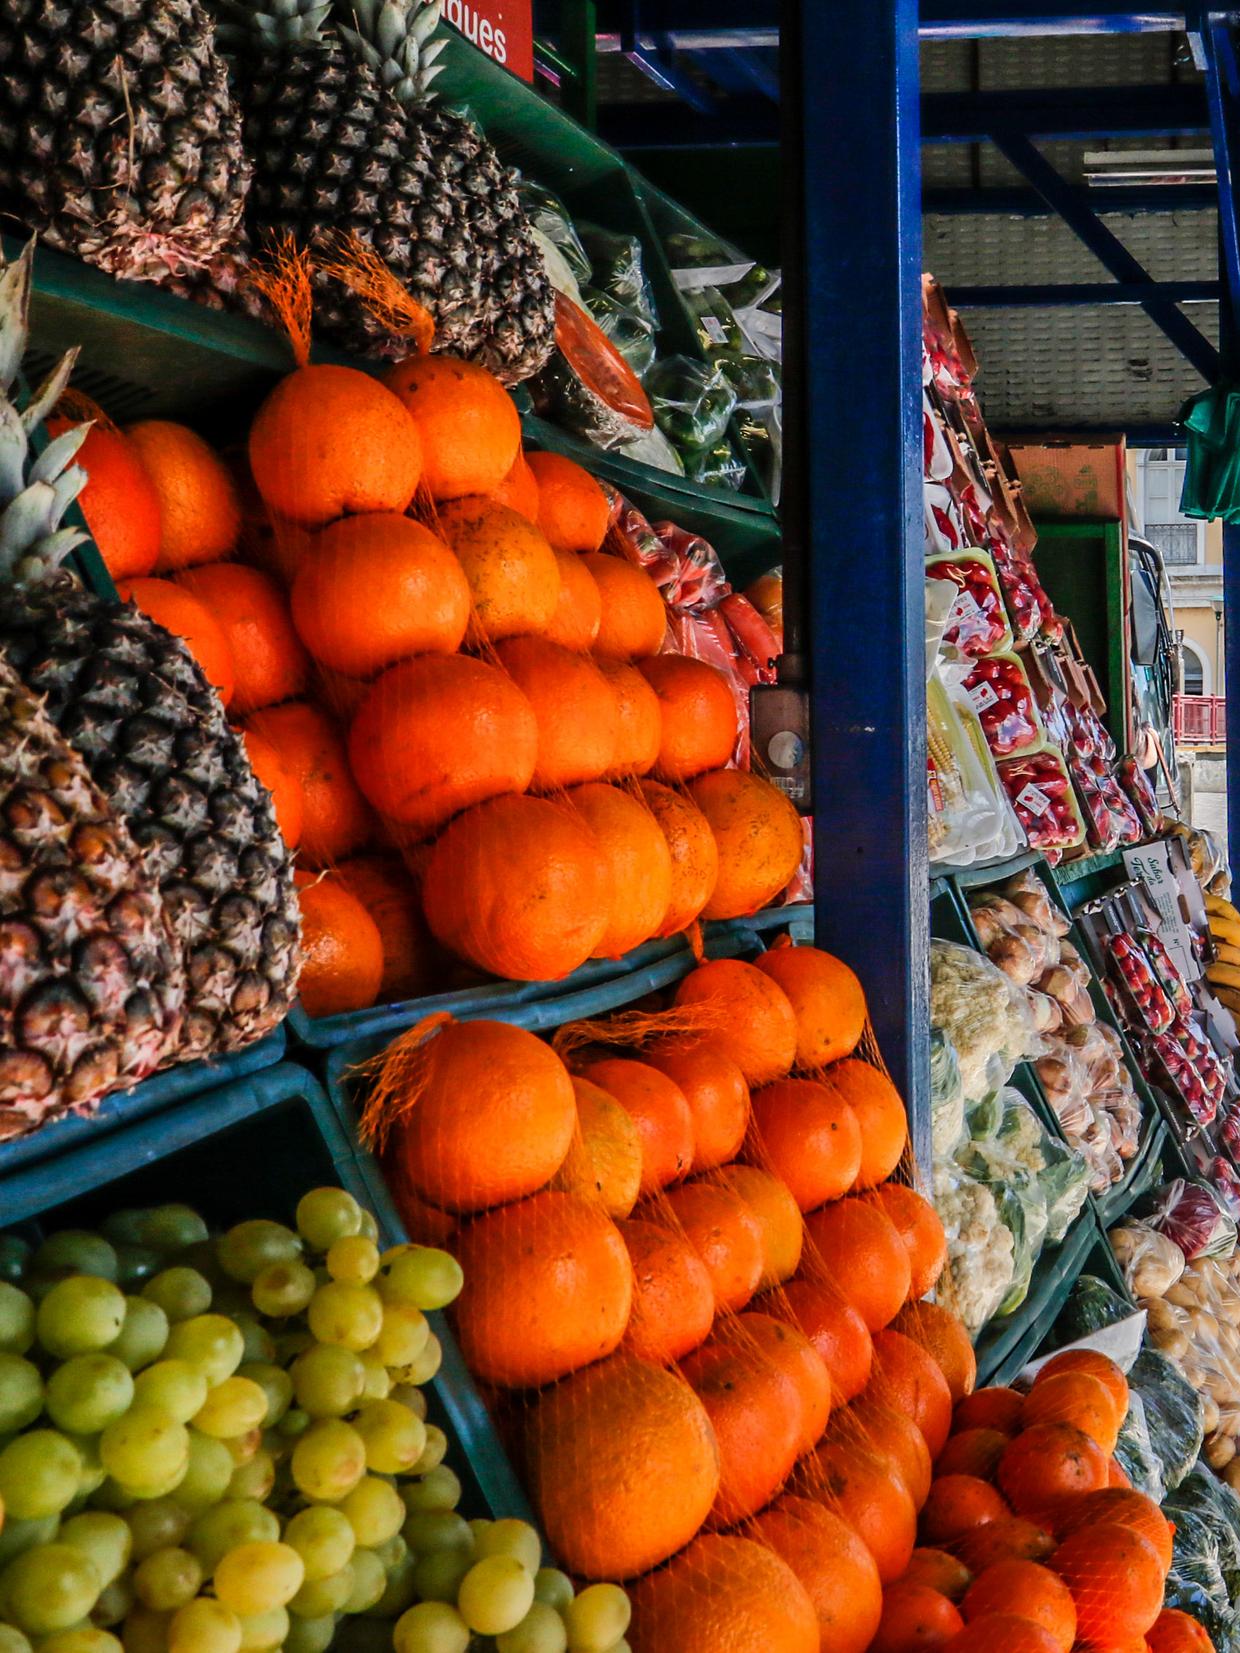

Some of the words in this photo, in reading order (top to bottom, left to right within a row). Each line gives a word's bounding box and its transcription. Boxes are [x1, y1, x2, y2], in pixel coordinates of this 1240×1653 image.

[422, 0, 507, 63] ques
[1130, 857, 1150, 879] Ter
[1147, 857, 1164, 884] Sabor
